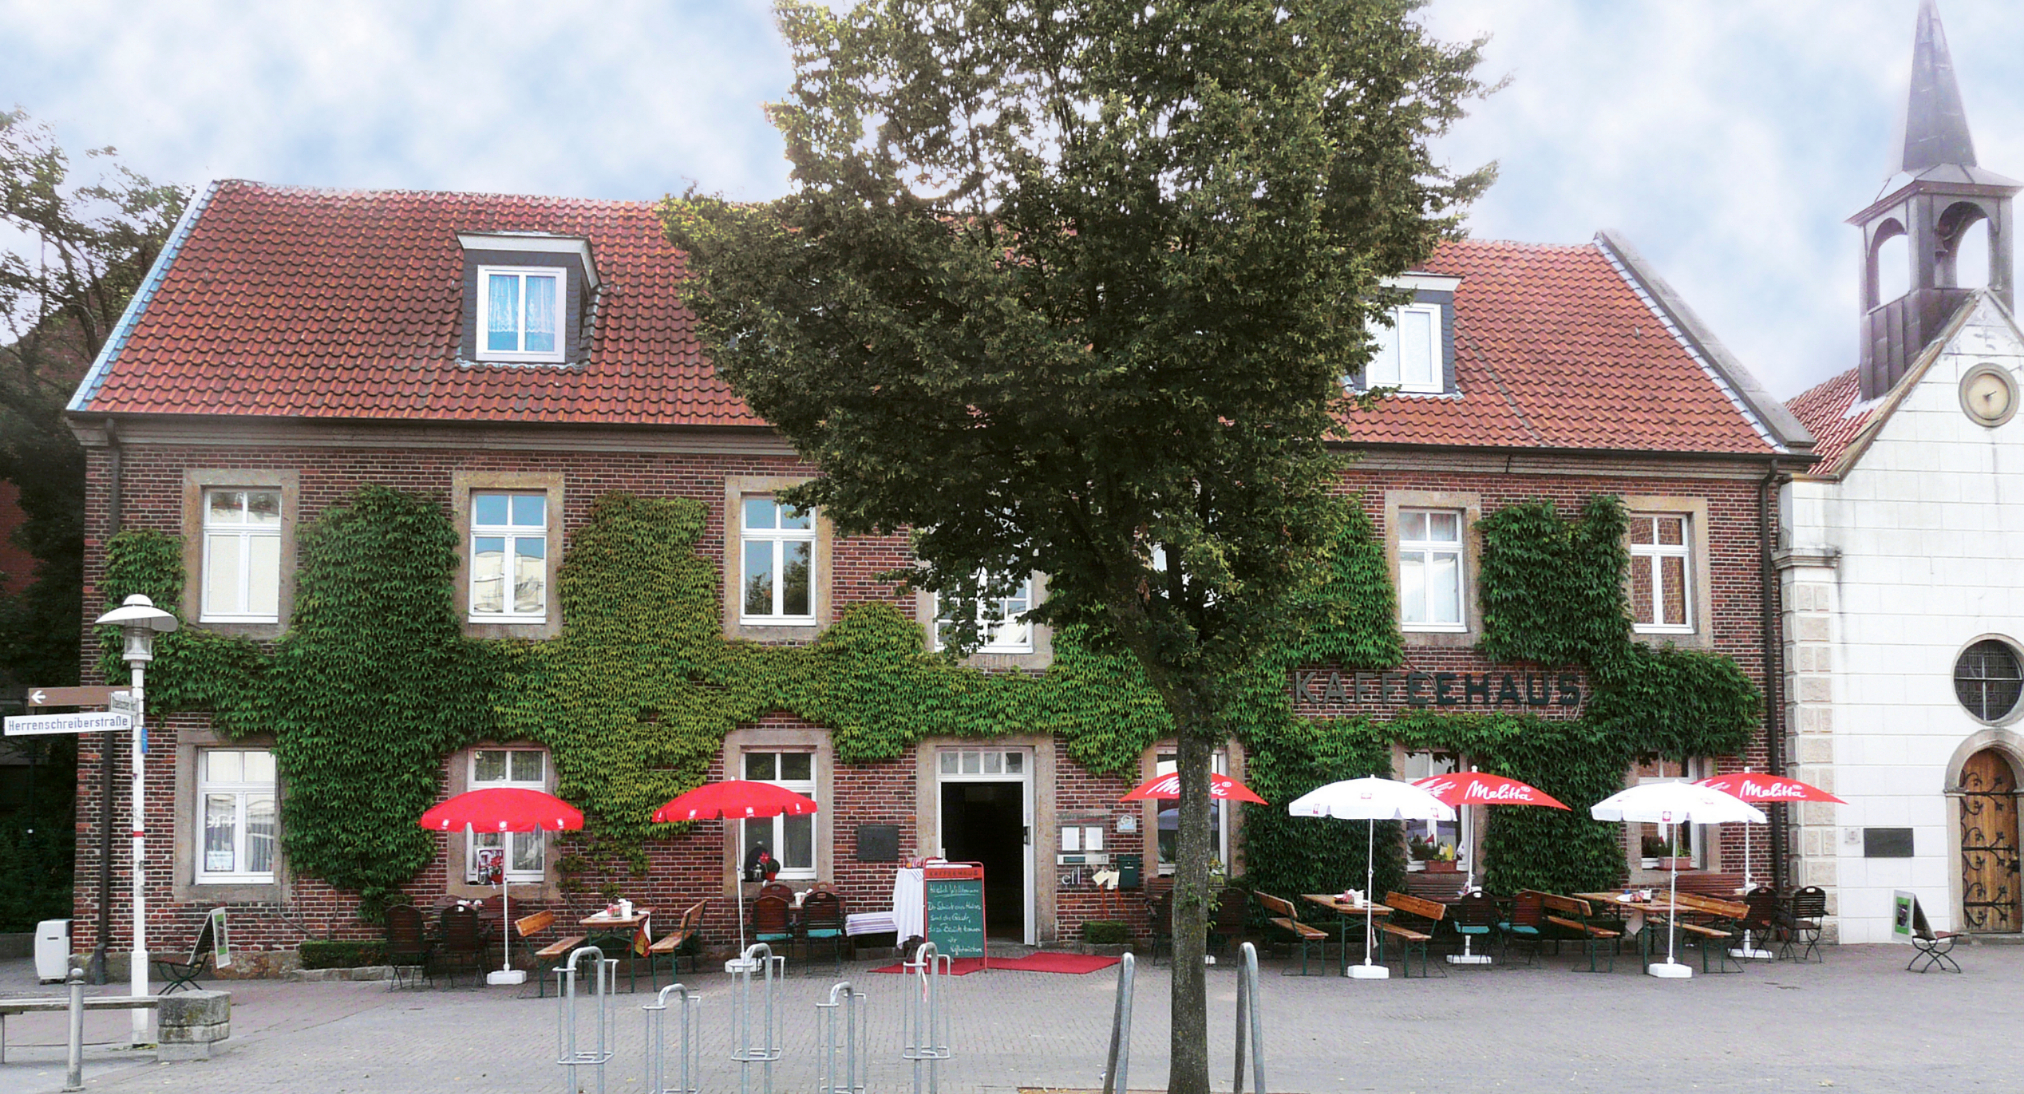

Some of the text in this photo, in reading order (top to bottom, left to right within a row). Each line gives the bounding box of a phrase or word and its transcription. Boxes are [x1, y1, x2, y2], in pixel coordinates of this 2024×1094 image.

[1295, 671, 1582, 706] KAFFEEHAUS
[8, 715, 129, 732] Herrenschreiberstraße
[1464, 780, 1534, 801] Melitta
[1739, 779, 1807, 799] Melitta
